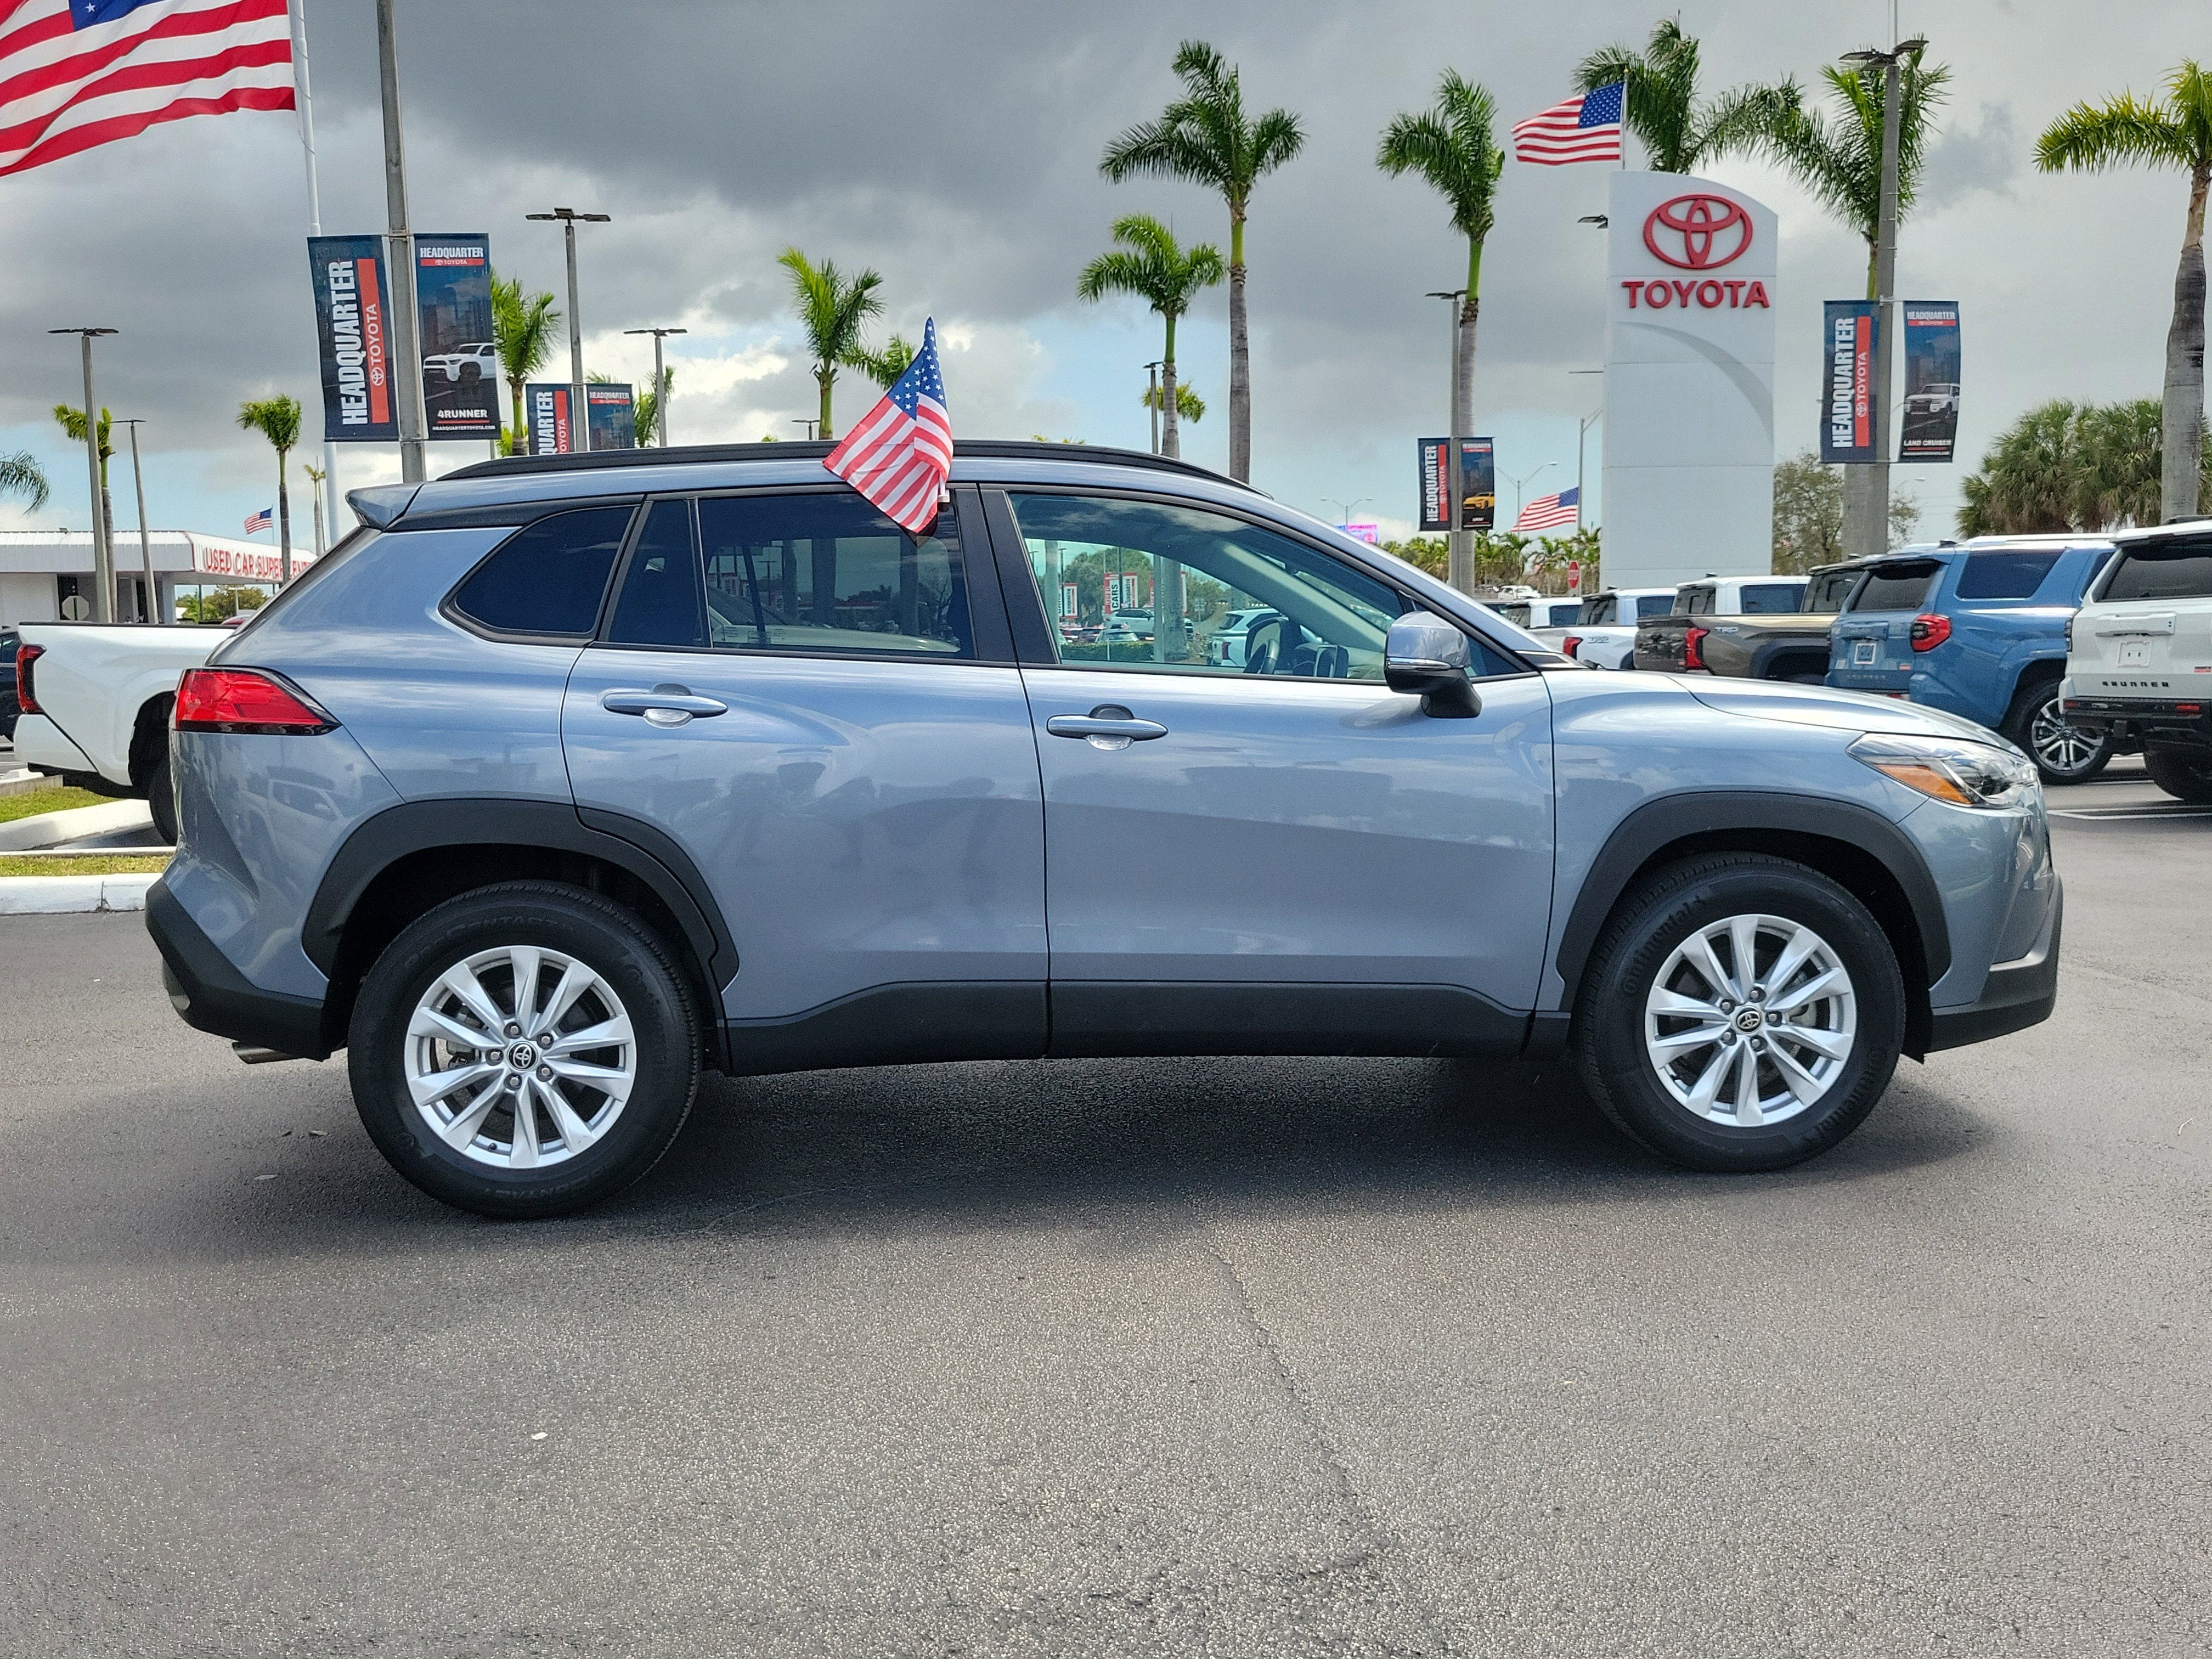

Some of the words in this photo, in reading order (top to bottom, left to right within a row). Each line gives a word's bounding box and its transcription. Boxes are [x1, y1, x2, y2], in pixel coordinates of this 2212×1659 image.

[420, 247, 483, 259] HEADQUARTER
[1621, 280, 1770, 308] TOYOTA
[1907, 311, 1955, 320] HEADQUARTER
[329, 260, 368, 425] HEADQUARTER
[366, 303, 385, 365] TOYOTA
[1832, 317, 1855, 448] HEADQUARTER
[1857, 351, 1868, 400] TOYOTA
[437, 409, 488, 418] 4RUNNER
[558, 419, 567, 454] OYOTA
[1425, 445, 1438, 522] HEADQUARTER
[205, 548, 232, 572] USED
[235, 552, 255, 575] CAR
